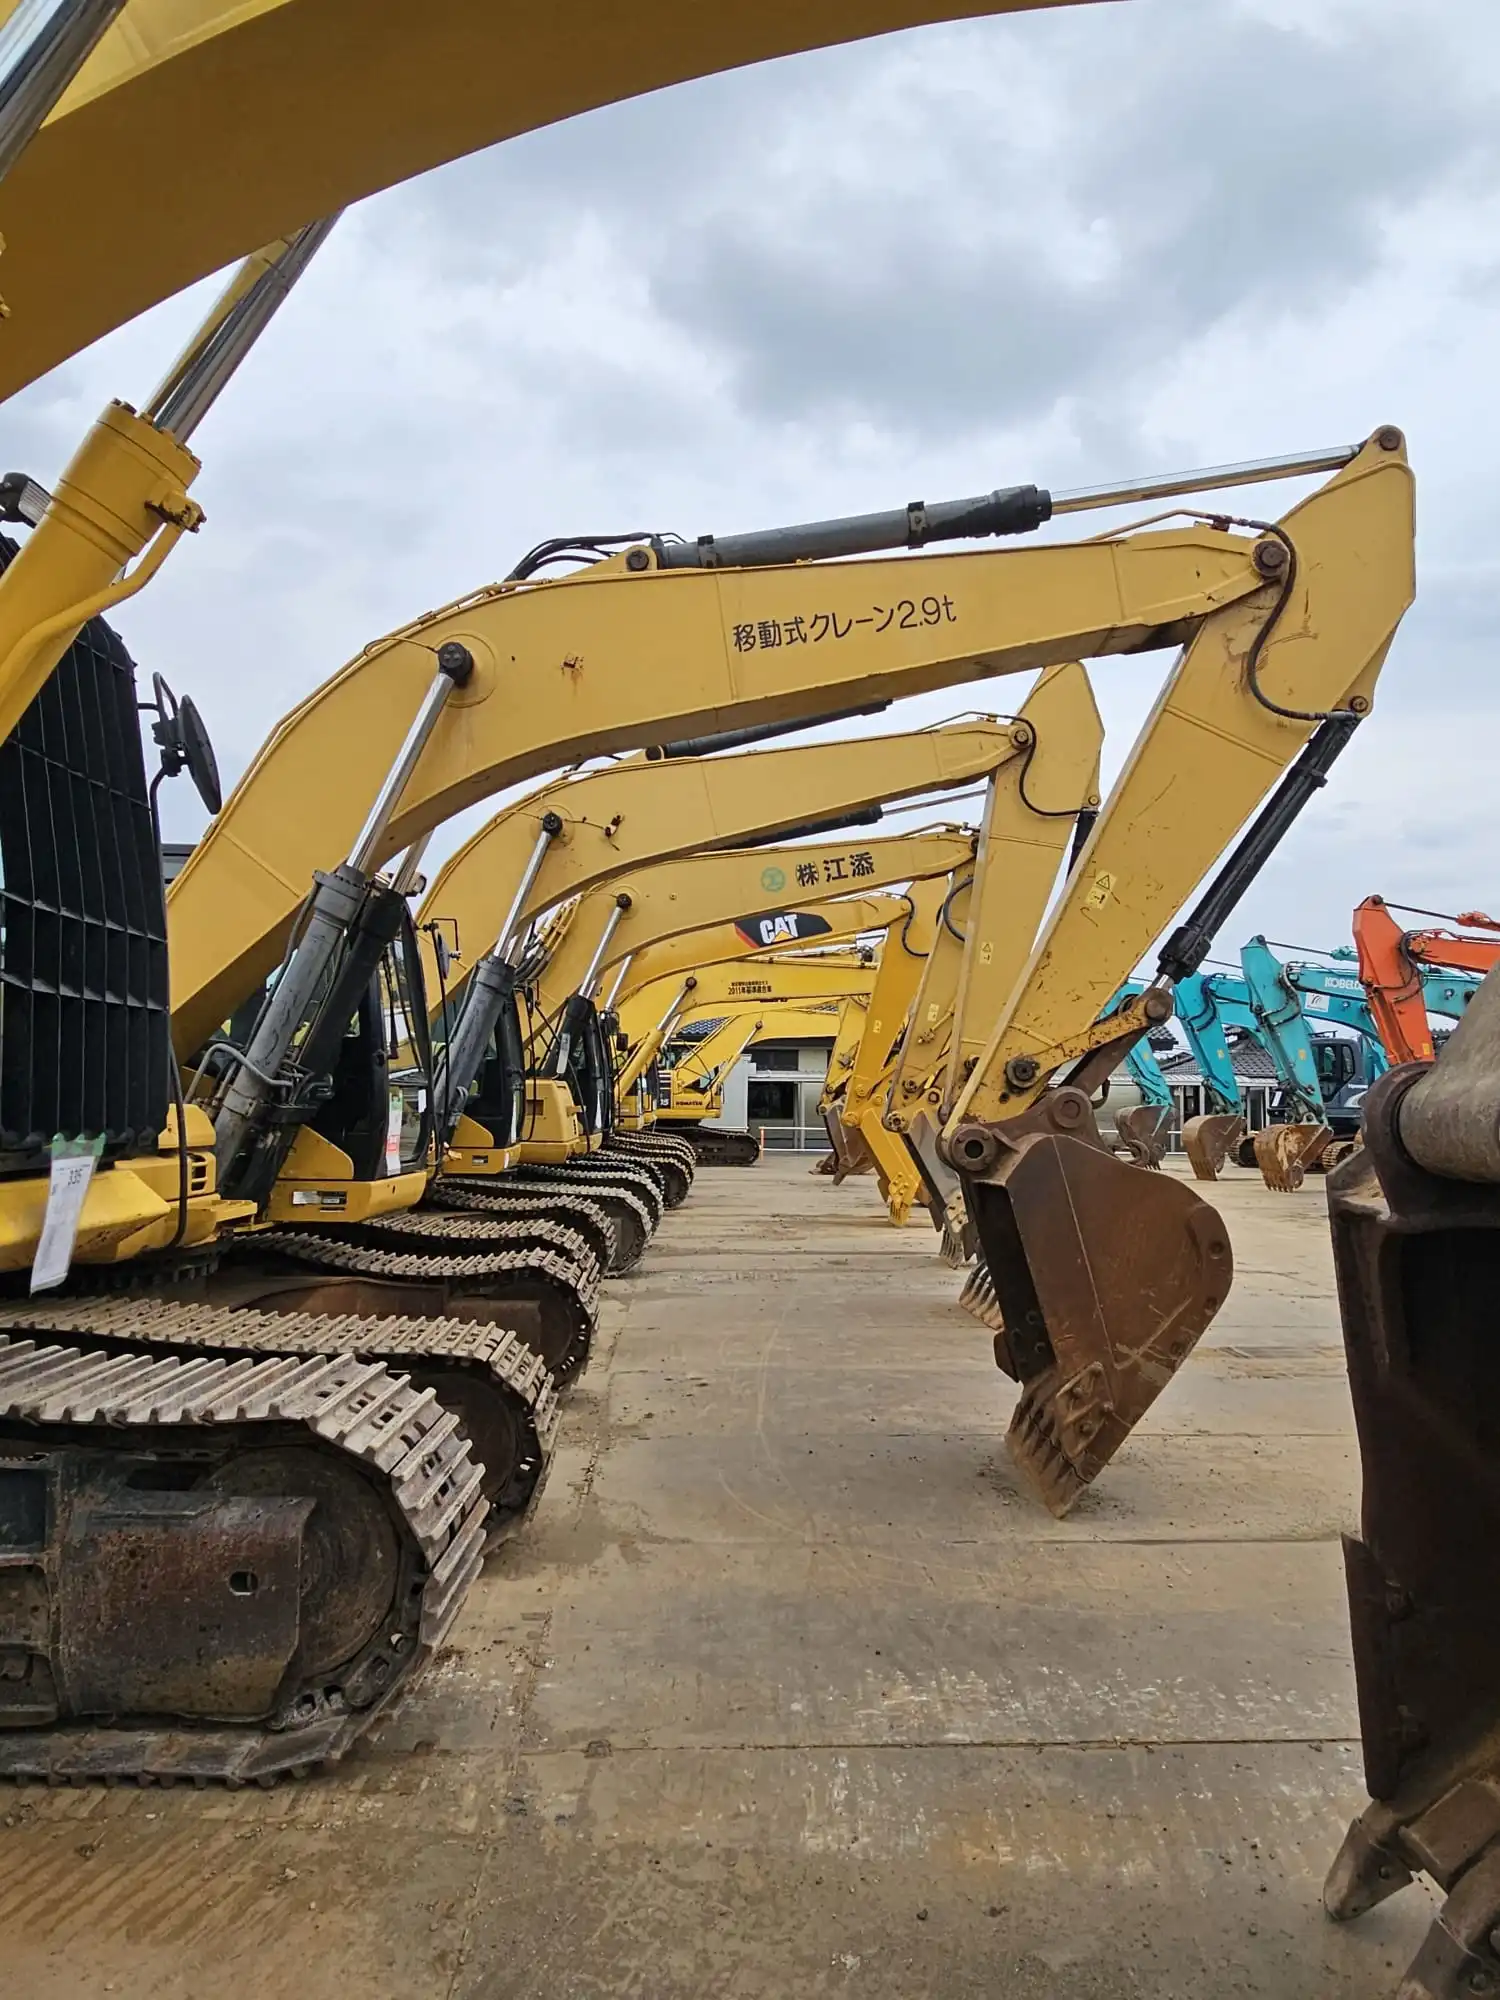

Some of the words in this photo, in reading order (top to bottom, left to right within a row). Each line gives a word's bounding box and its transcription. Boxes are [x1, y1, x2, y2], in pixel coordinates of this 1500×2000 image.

[732, 594, 957, 653] 移動式クレーン2.9t
[759, 914, 798, 944] CAT
[1324, 976, 1364, 991] KOBELC
